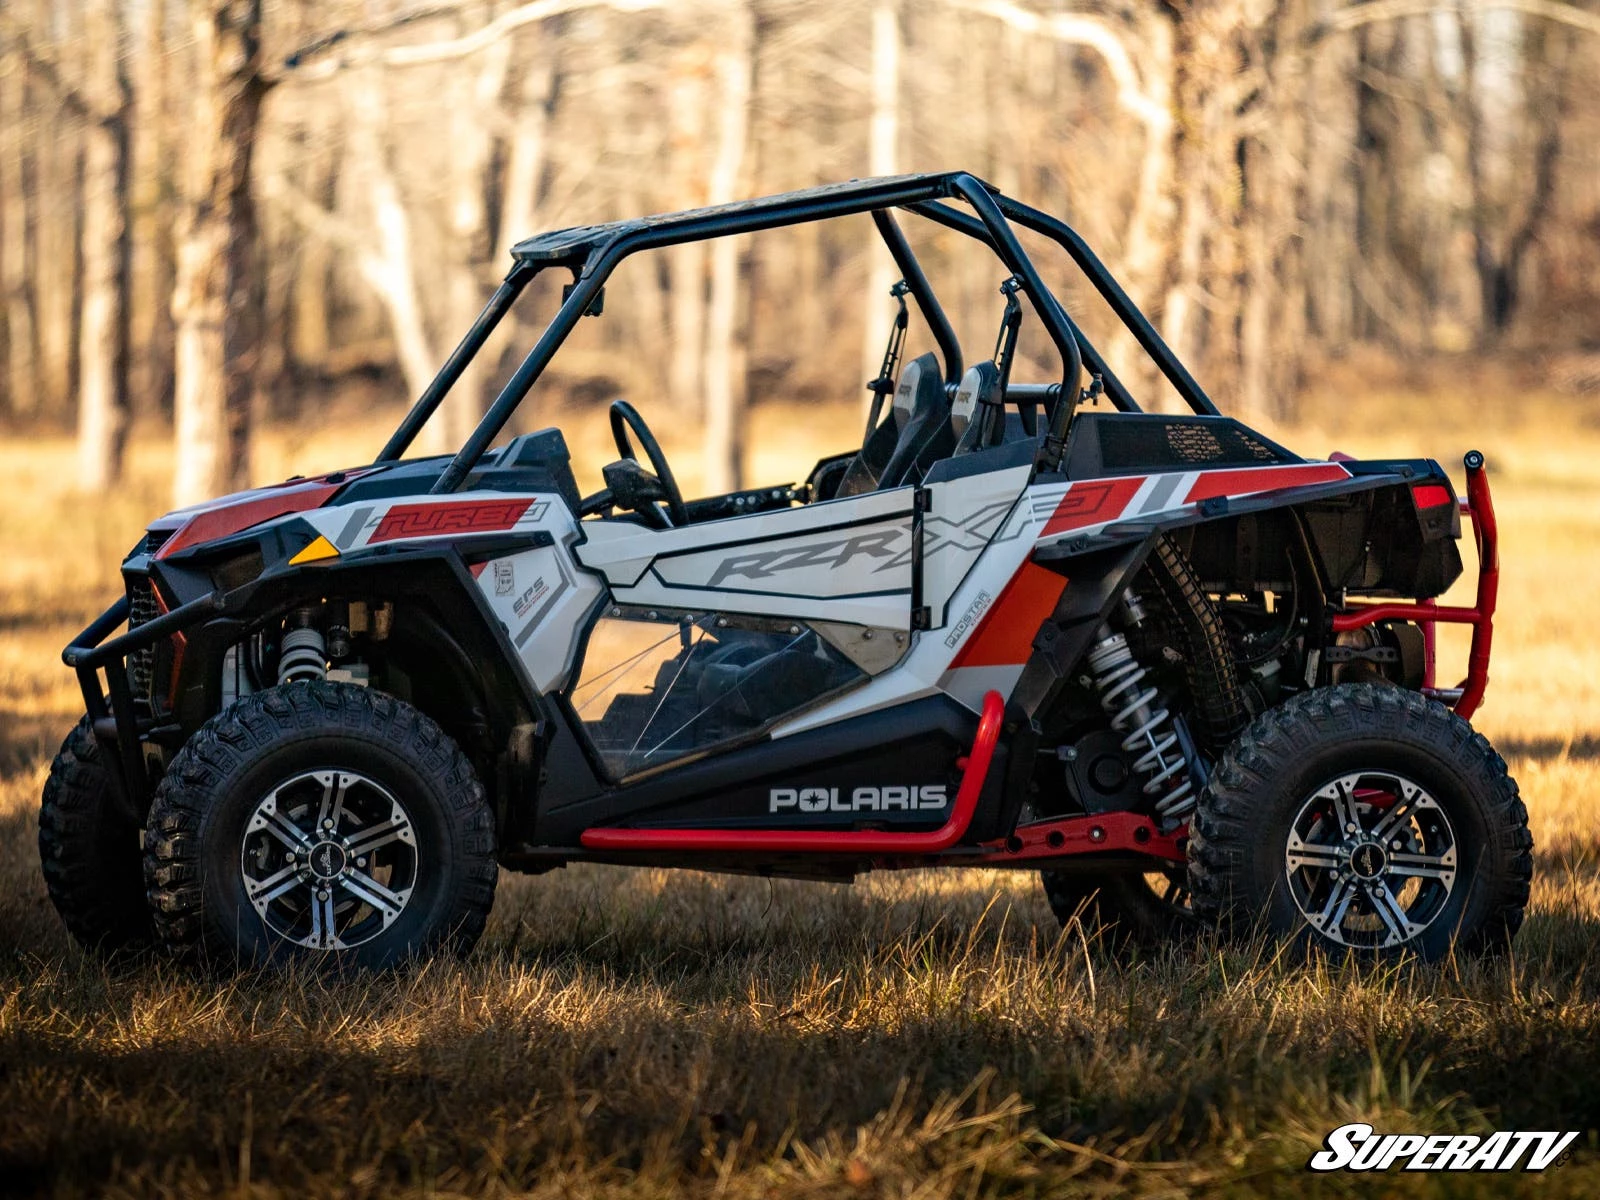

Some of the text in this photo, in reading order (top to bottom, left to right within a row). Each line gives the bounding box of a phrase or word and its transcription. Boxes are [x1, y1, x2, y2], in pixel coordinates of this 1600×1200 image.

[364, 501, 551, 537] TURBO
[706, 529, 903, 587] RZR
[513, 576, 544, 613] EPS
[944, 590, 990, 648] PROSTAR
[769, 785, 947, 812] POLARIS
